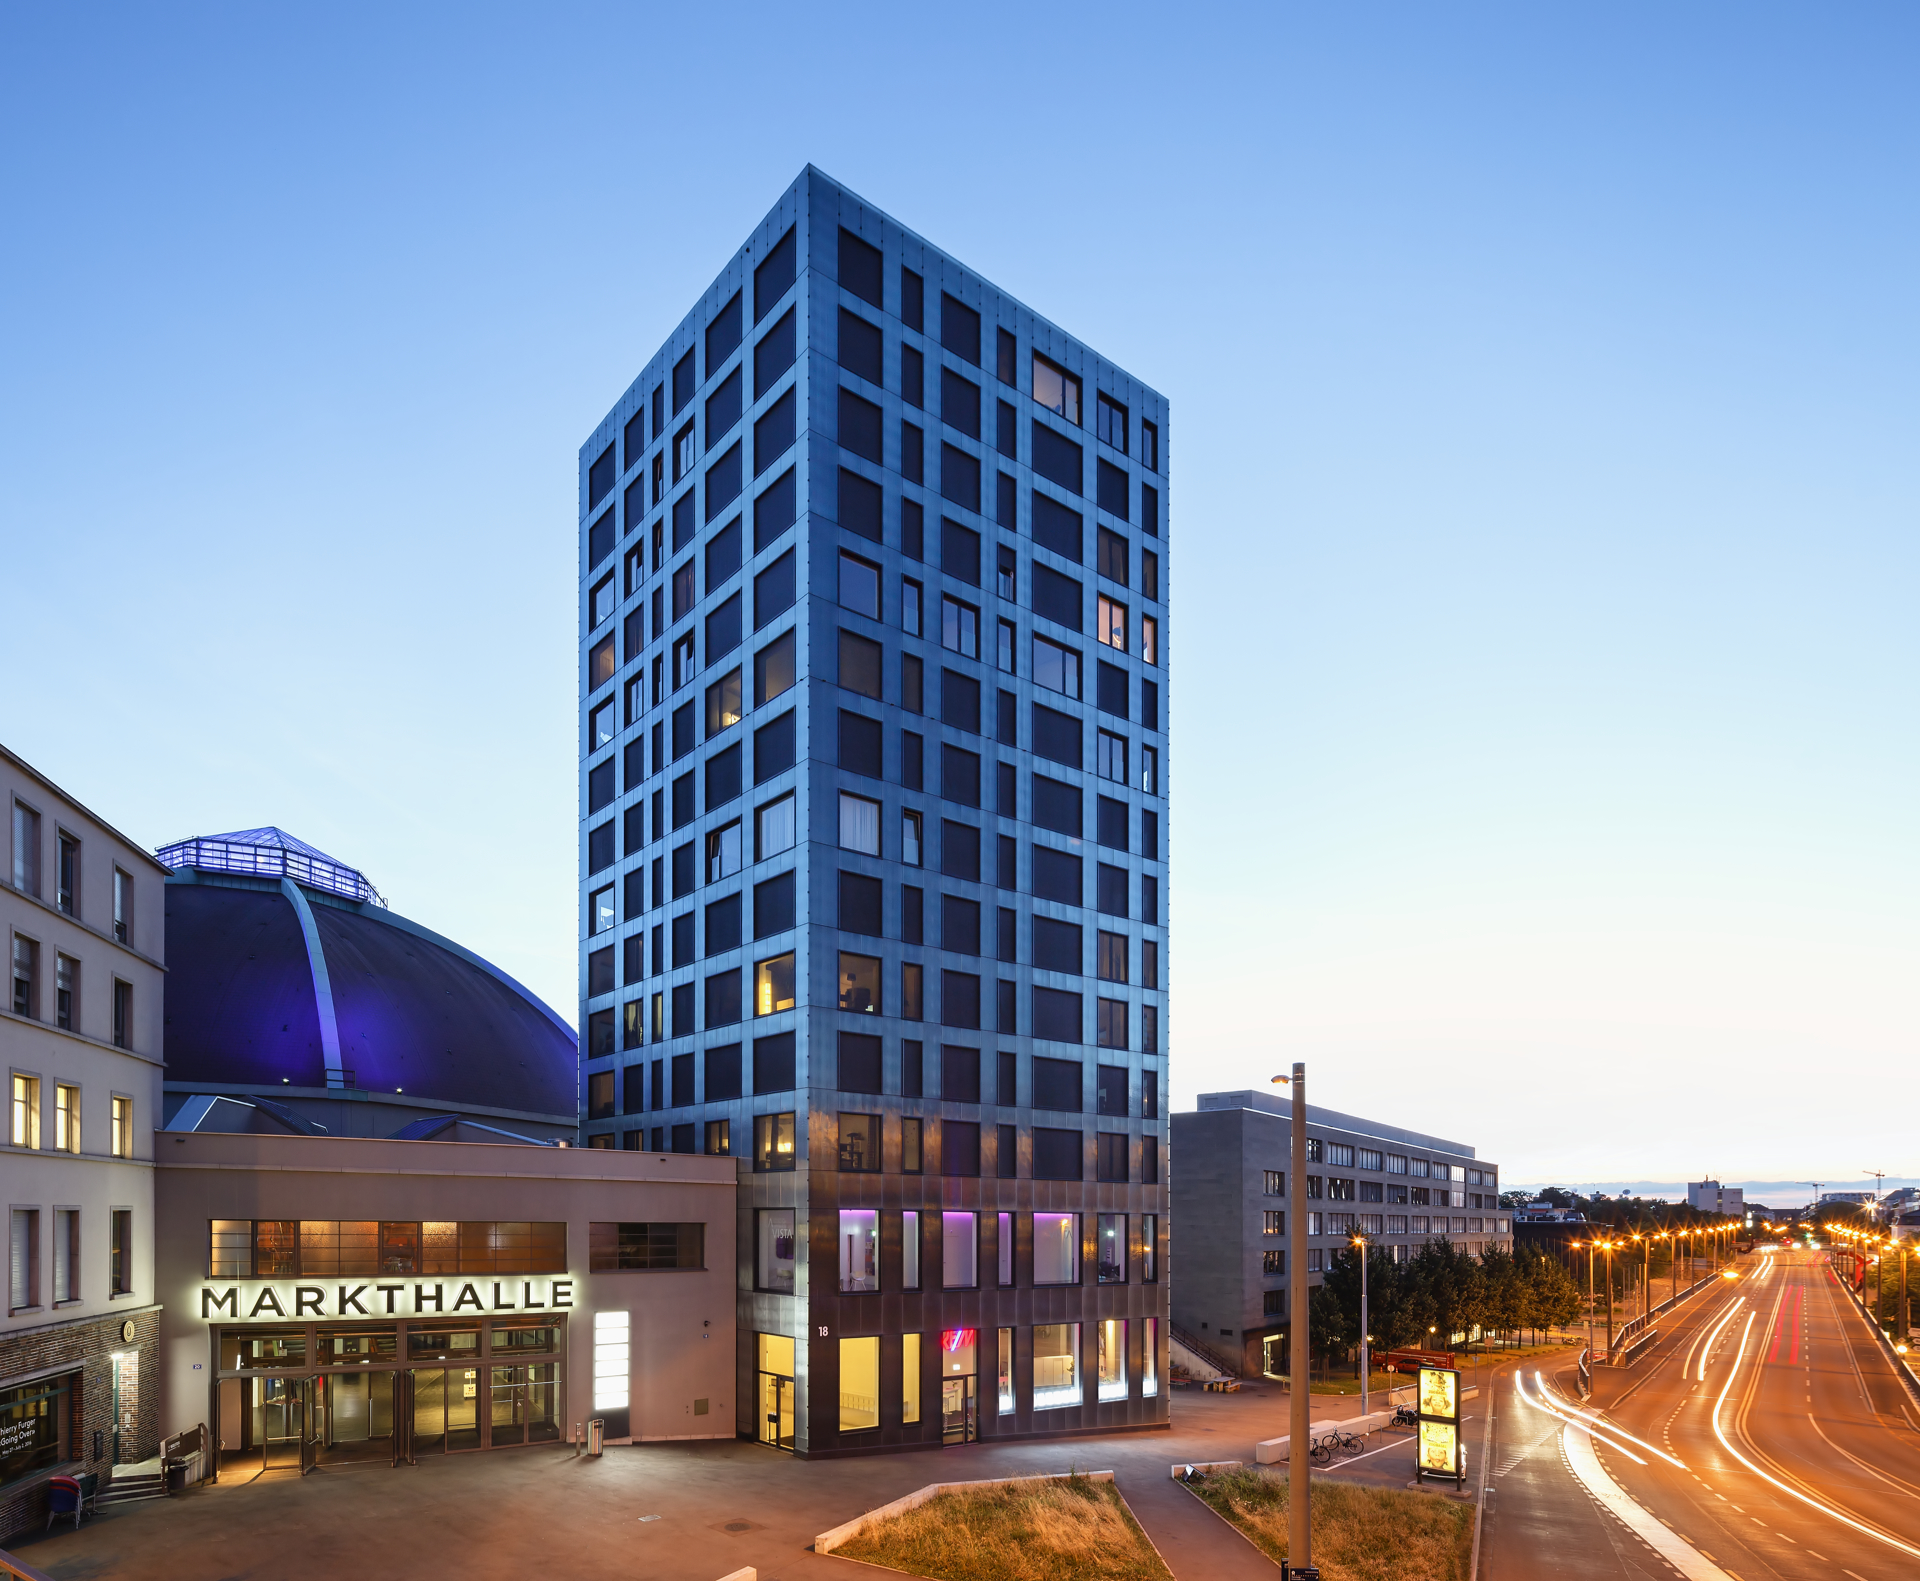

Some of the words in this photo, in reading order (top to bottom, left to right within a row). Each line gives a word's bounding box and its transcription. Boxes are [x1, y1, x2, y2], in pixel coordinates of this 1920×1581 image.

[772, 1228, 793, 1240] VISTA
[201, 1280, 573, 1319] MARKTHALLE
[818, 1326, 829, 1337] 18
[0, 1424, 17, 1435] hierry
[18, 1418, 36, 1429] Furger
